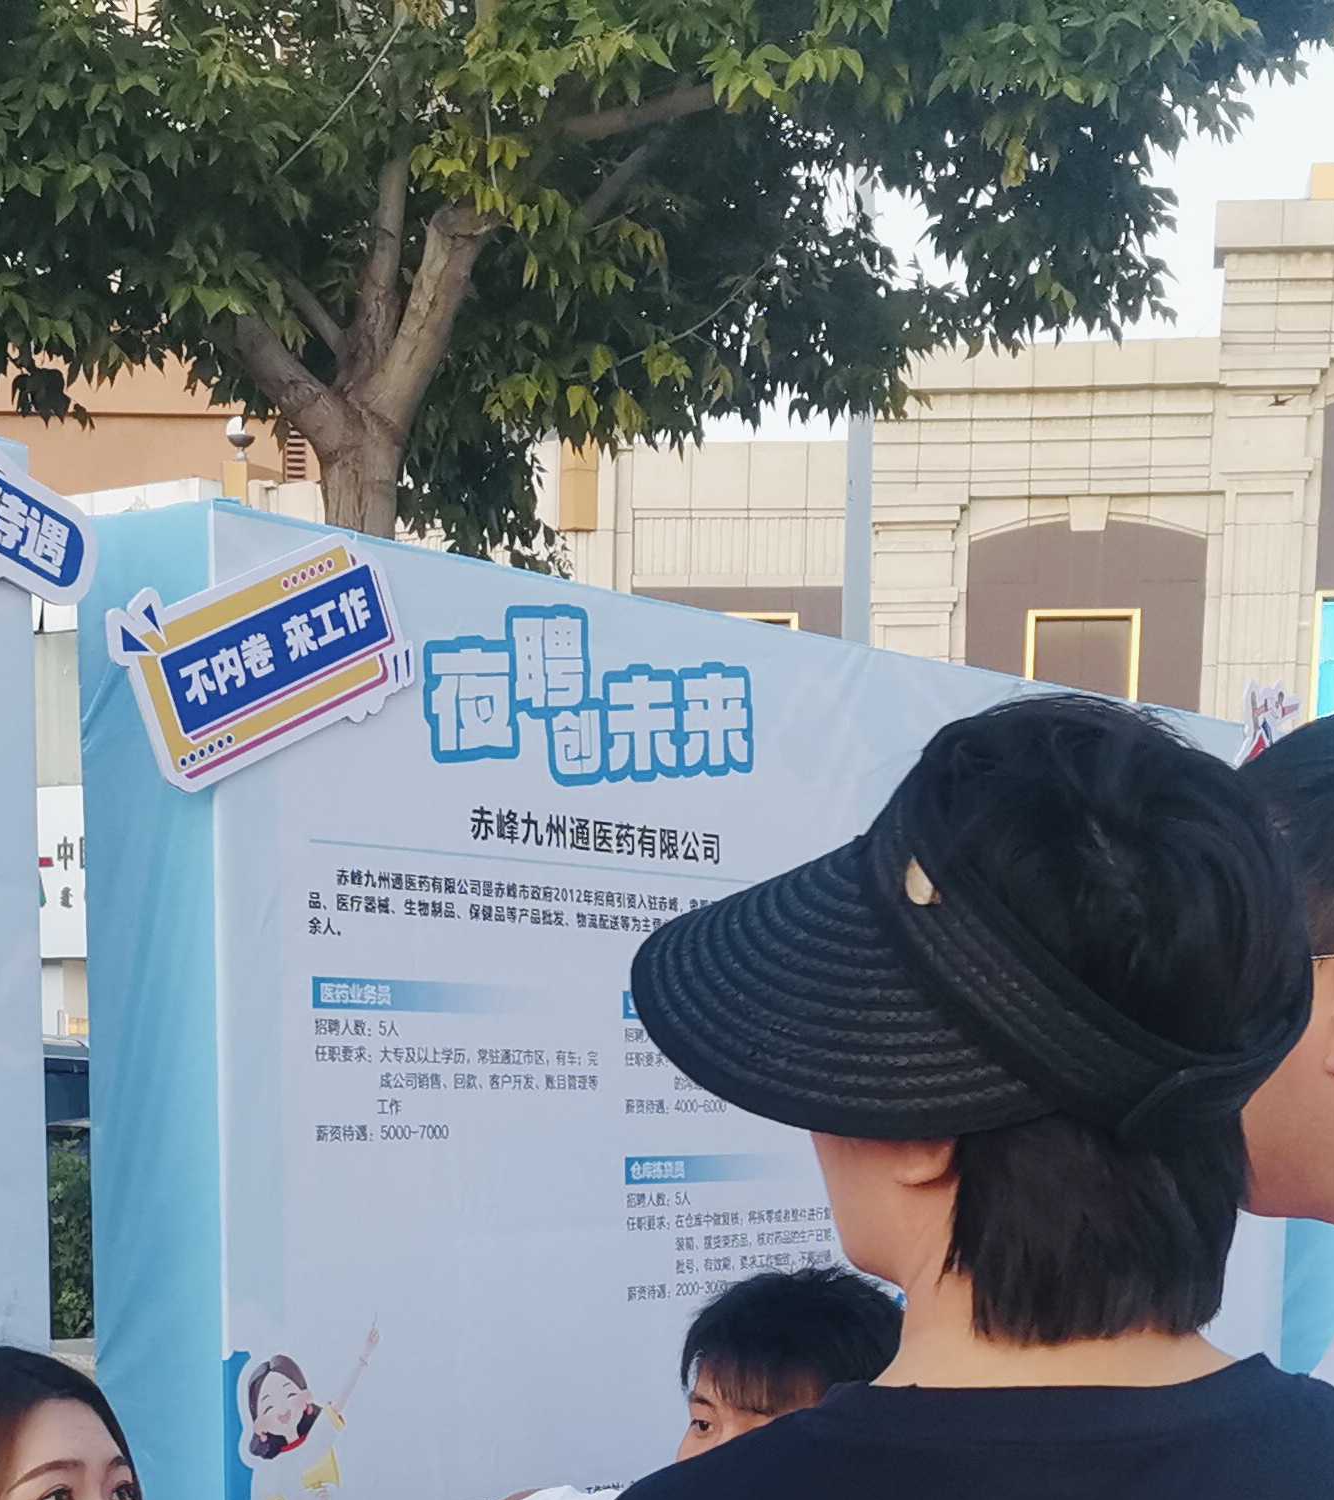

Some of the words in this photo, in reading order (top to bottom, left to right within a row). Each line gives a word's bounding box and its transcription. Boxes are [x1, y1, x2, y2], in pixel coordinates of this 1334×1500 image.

[283, 586, 372, 660] 来工作
[178, 636, 275, 707] 不内卷
[427, 609, 750, 781] 夜聘创未来
[470, 806, 721, 865] 赤峰九州通医药有限公司
[377, 1099, 402, 1115] 工作
